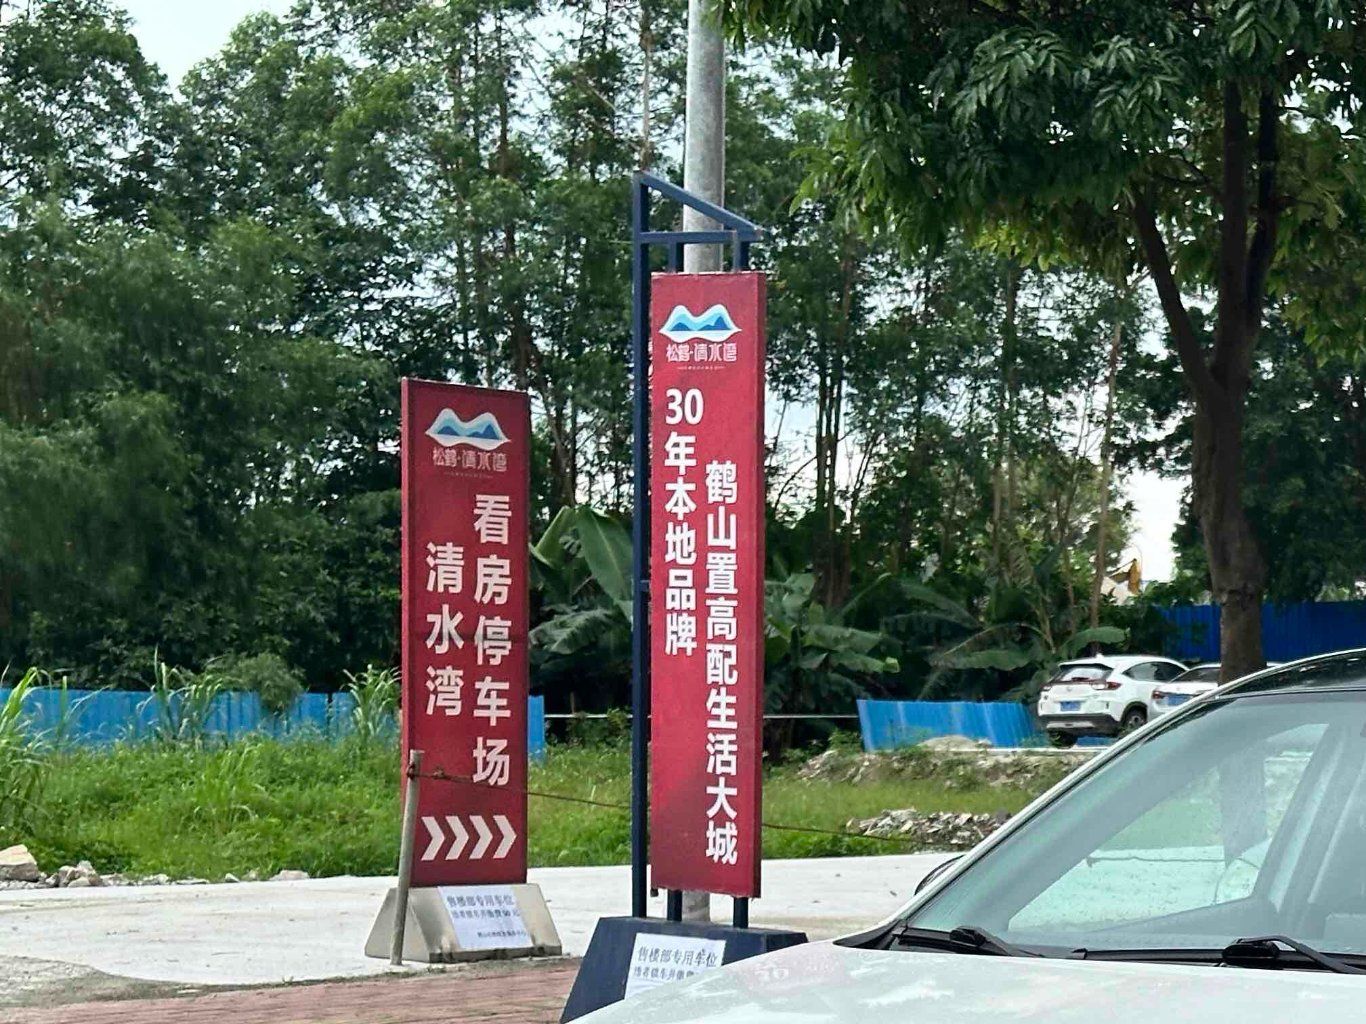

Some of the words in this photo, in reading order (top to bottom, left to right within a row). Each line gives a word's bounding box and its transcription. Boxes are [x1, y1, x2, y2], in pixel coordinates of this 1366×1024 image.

[424, 541, 466, 718] 清水湾
[471, 493, 513, 788] 看房停车场
[664, 387, 704, 657] 30年本地品牌
[704, 459, 739, 867] 鹤山置高配生活大城
